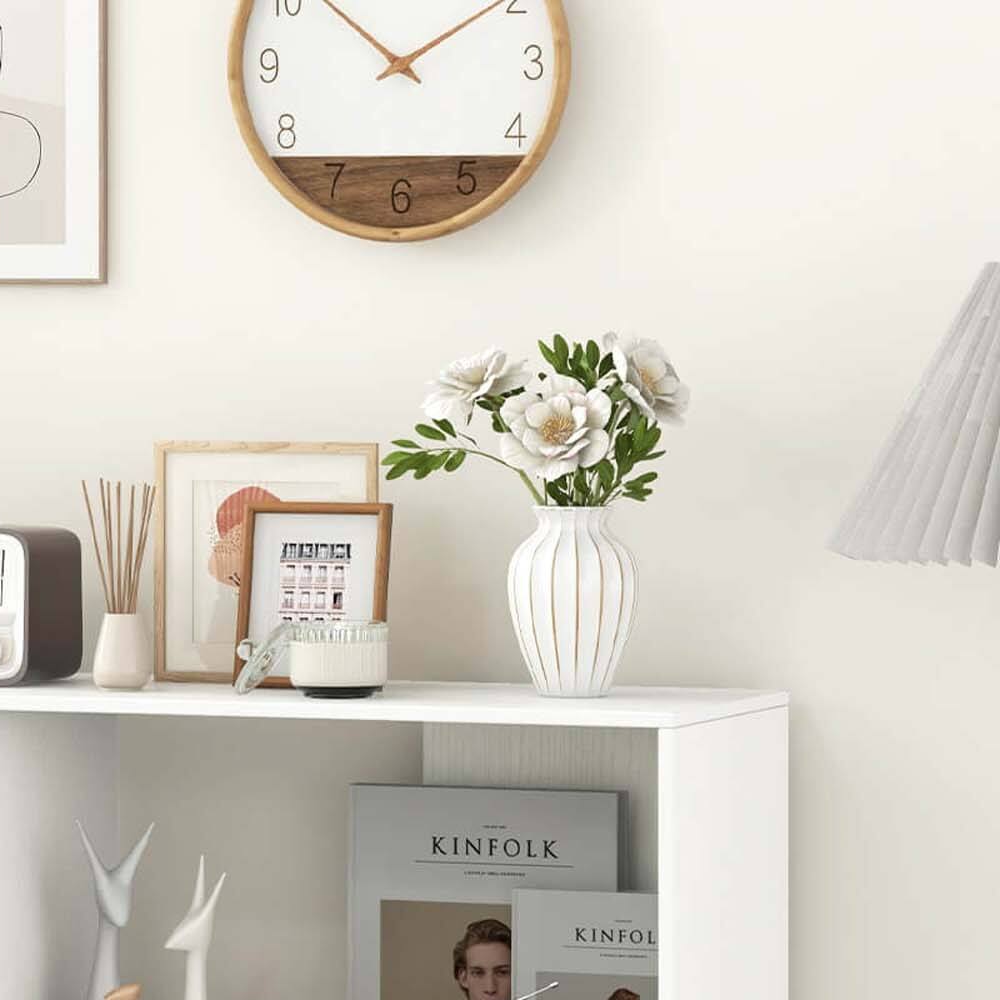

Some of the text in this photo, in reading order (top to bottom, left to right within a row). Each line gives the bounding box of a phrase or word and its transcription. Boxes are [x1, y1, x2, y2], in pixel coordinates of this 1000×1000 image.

[259, 47, 279, 84] 9
[523, 44, 544, 81] 3
[276, 113, 297, 149] 8
[503, 112, 527, 147] 4
[324, 162, 346, 199] 7
[455, 160, 478, 196] 5
[390, 179, 412, 214] 6
[431, 836, 560, 859] KINFOLK
